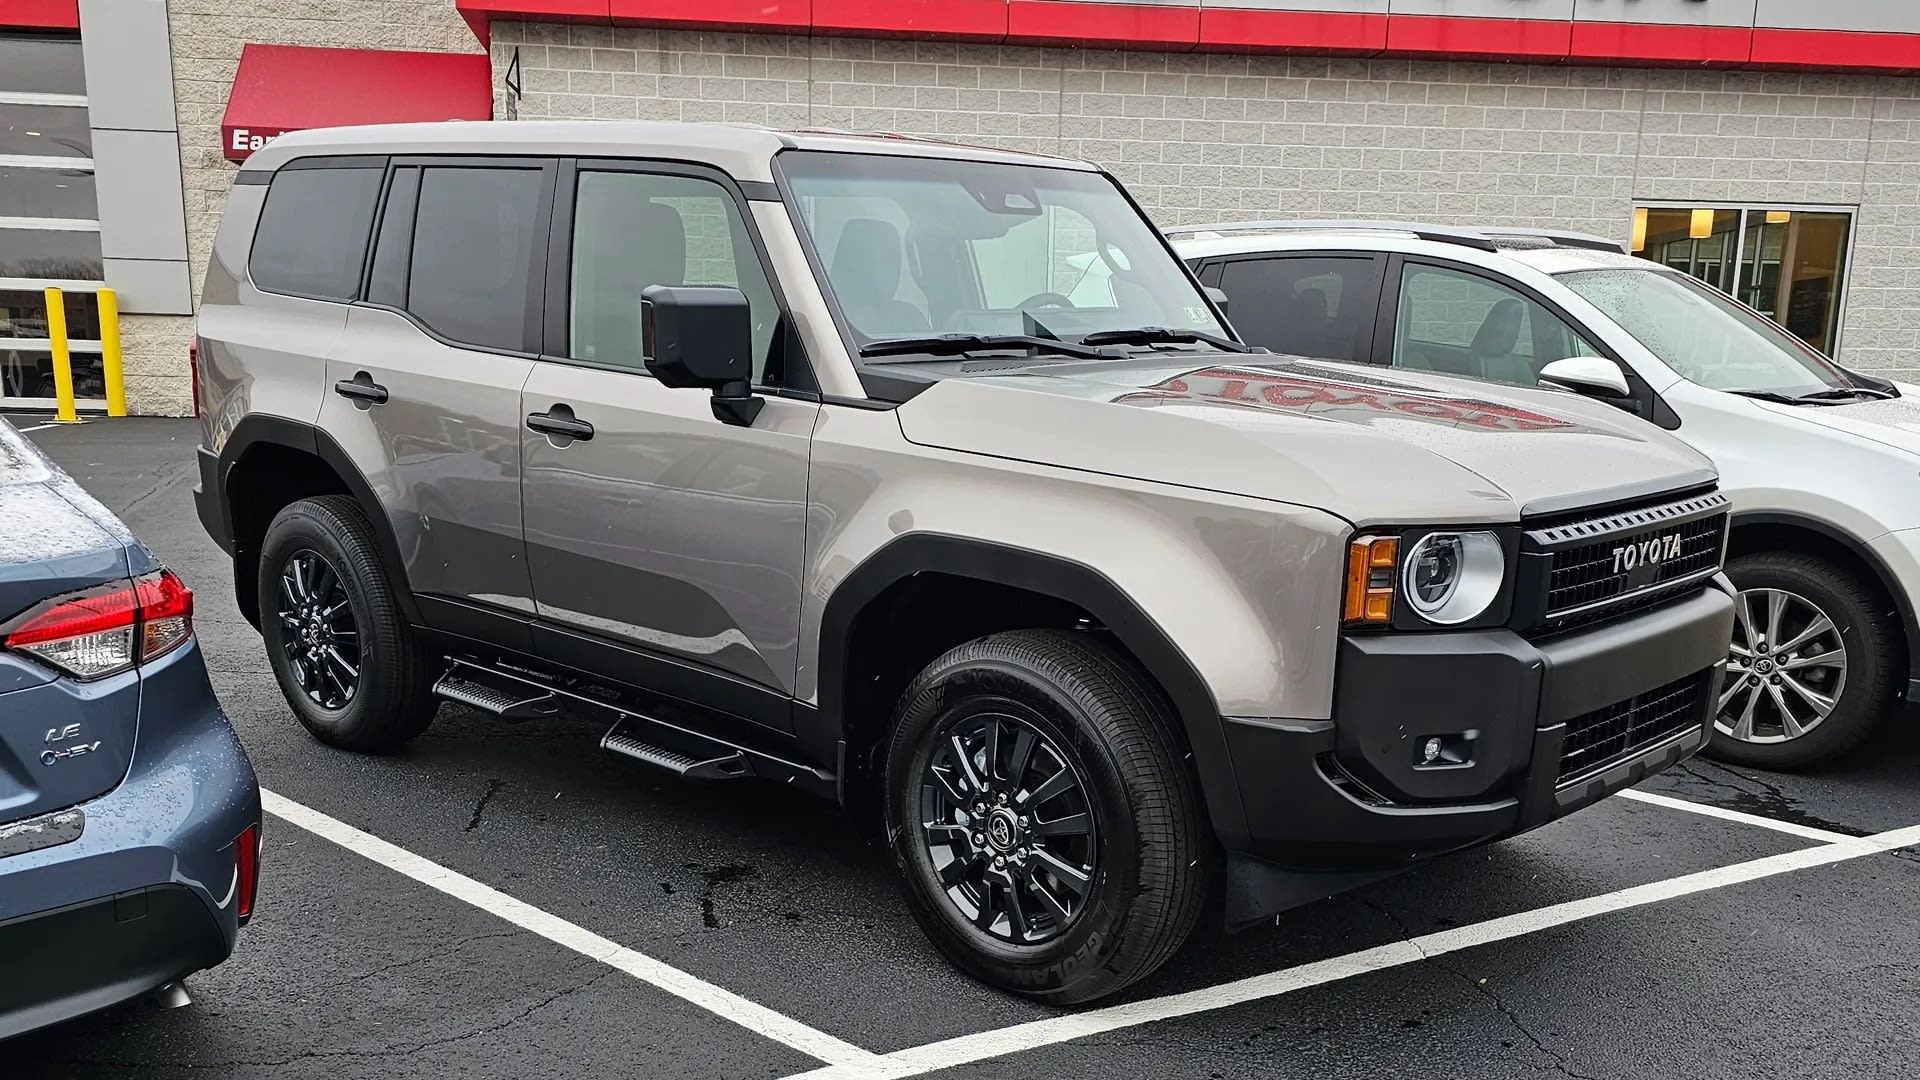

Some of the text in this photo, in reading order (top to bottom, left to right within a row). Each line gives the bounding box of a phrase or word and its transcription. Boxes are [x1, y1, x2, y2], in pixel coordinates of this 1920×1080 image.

[232, 129, 285, 151] Ear
[1612, 533, 1681, 574] TOYOTA
[45, 722, 81, 742] LE
